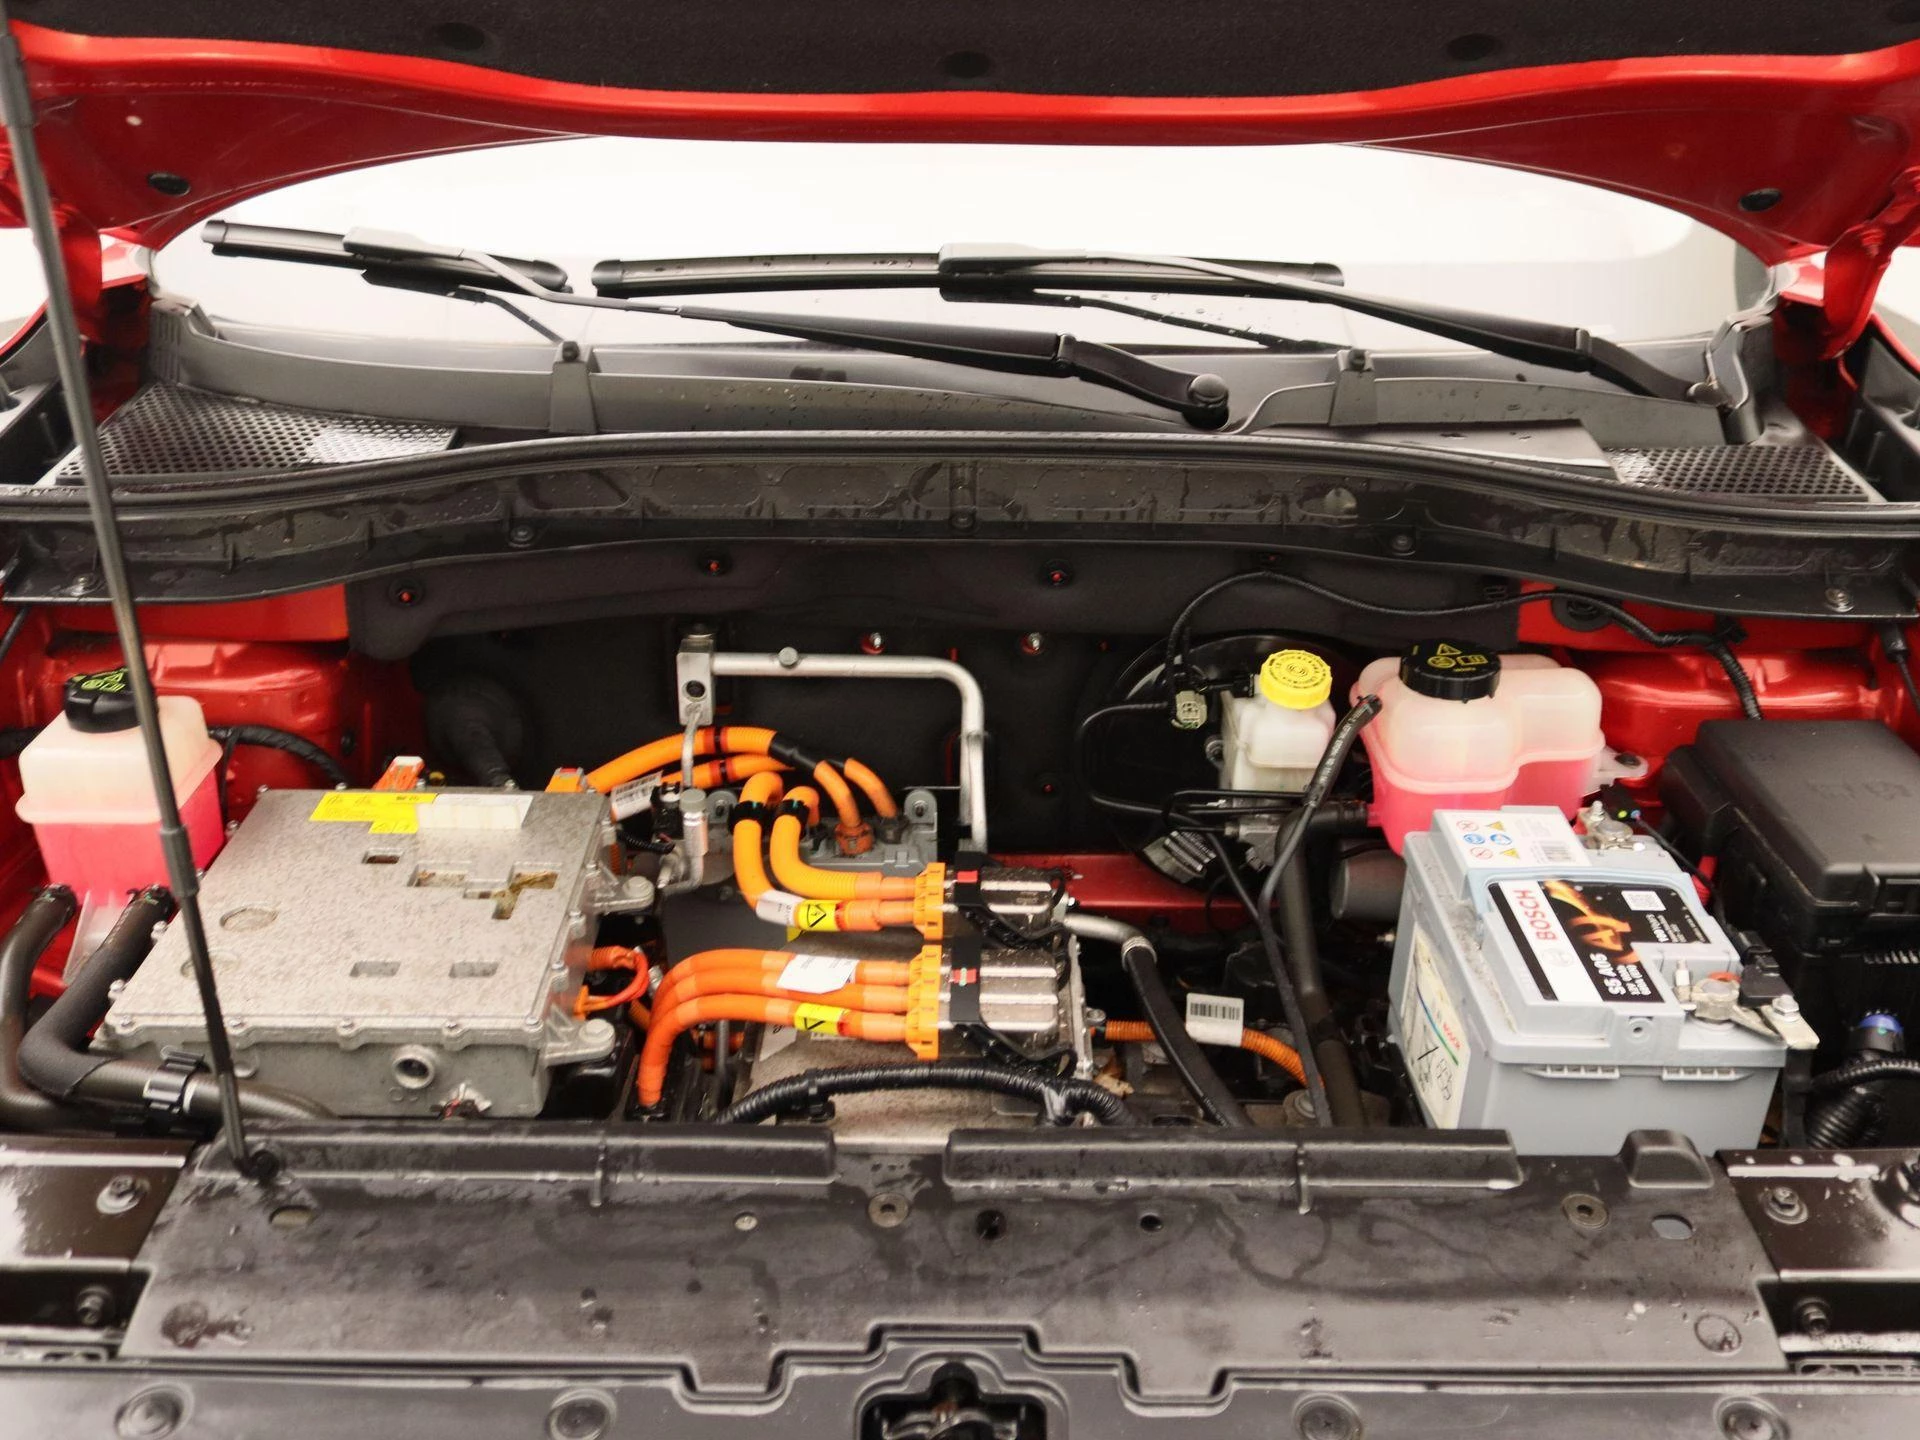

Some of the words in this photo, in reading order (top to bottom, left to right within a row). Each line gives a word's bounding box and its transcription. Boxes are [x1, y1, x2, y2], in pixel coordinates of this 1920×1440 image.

[1514, 889, 1557, 941] BOSCH
[1589, 953, 1617, 977] A05
[1604, 977, 1626, 995] S5
